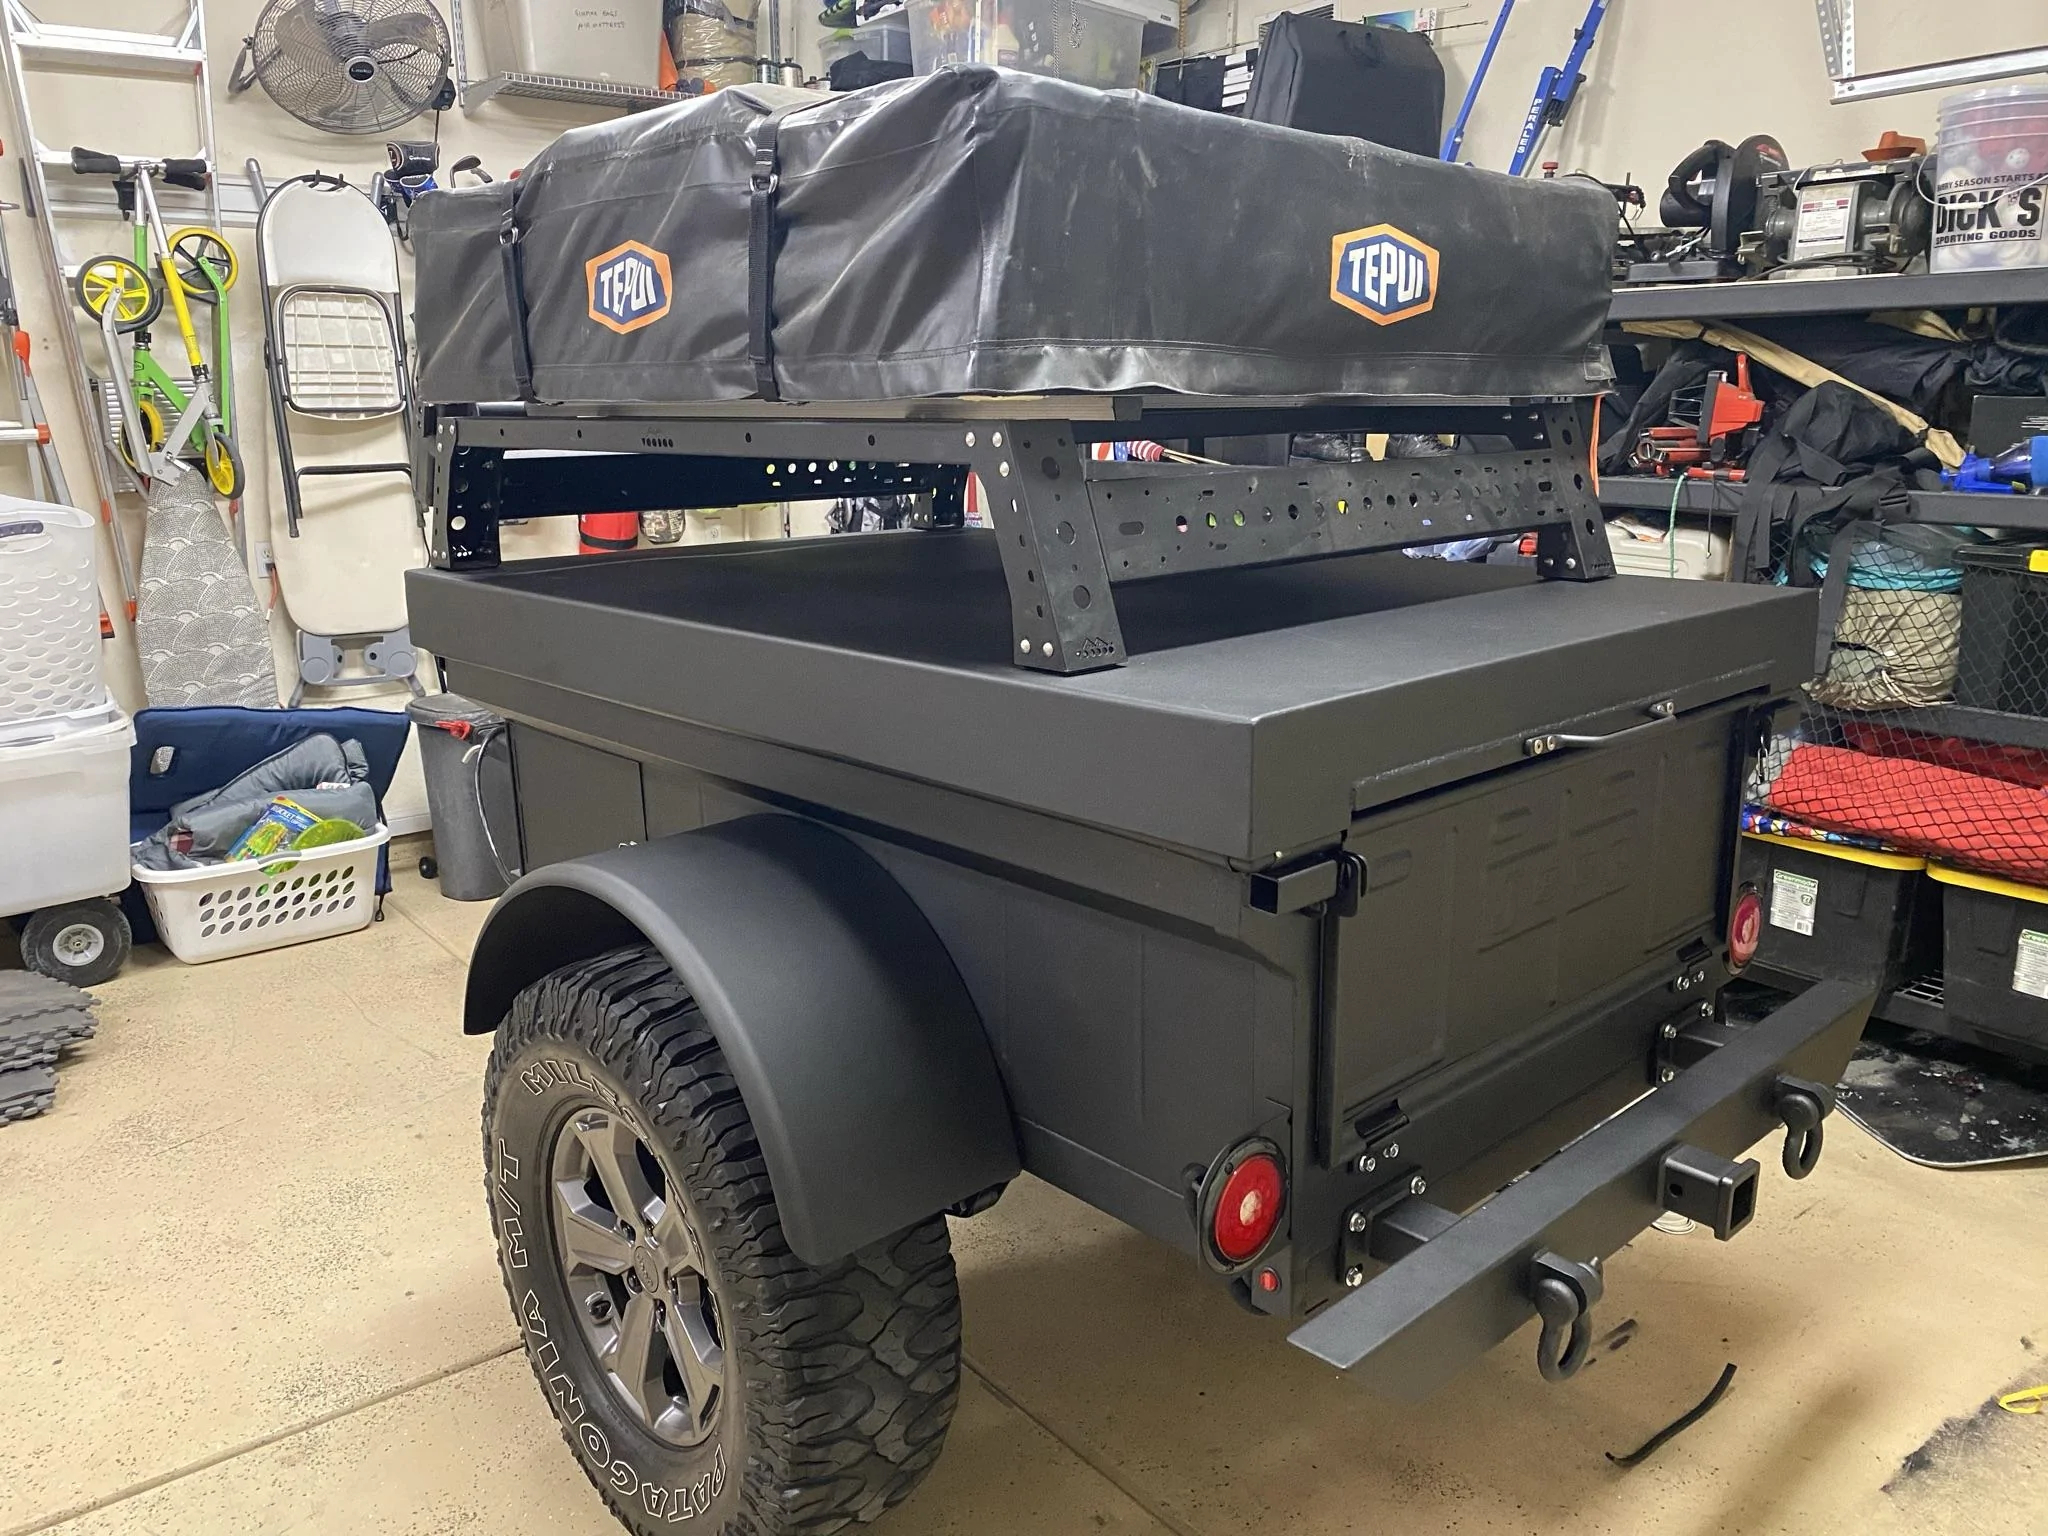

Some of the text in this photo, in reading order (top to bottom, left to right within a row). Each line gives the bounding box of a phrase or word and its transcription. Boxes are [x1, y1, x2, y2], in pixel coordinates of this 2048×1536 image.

[1516, 98, 1543, 154] PERALES
[1954, 176, 1991, 188] SEASON
[1993, 172, 2034, 184] STARTS
[1935, 229, 2036, 245] SPORTING GOODS
[600, 257, 656, 317] TEPUI
[1348, 241, 1424, 307] TEPUI
[498, 1138, 726, 1523] PATAGONIA M/T
